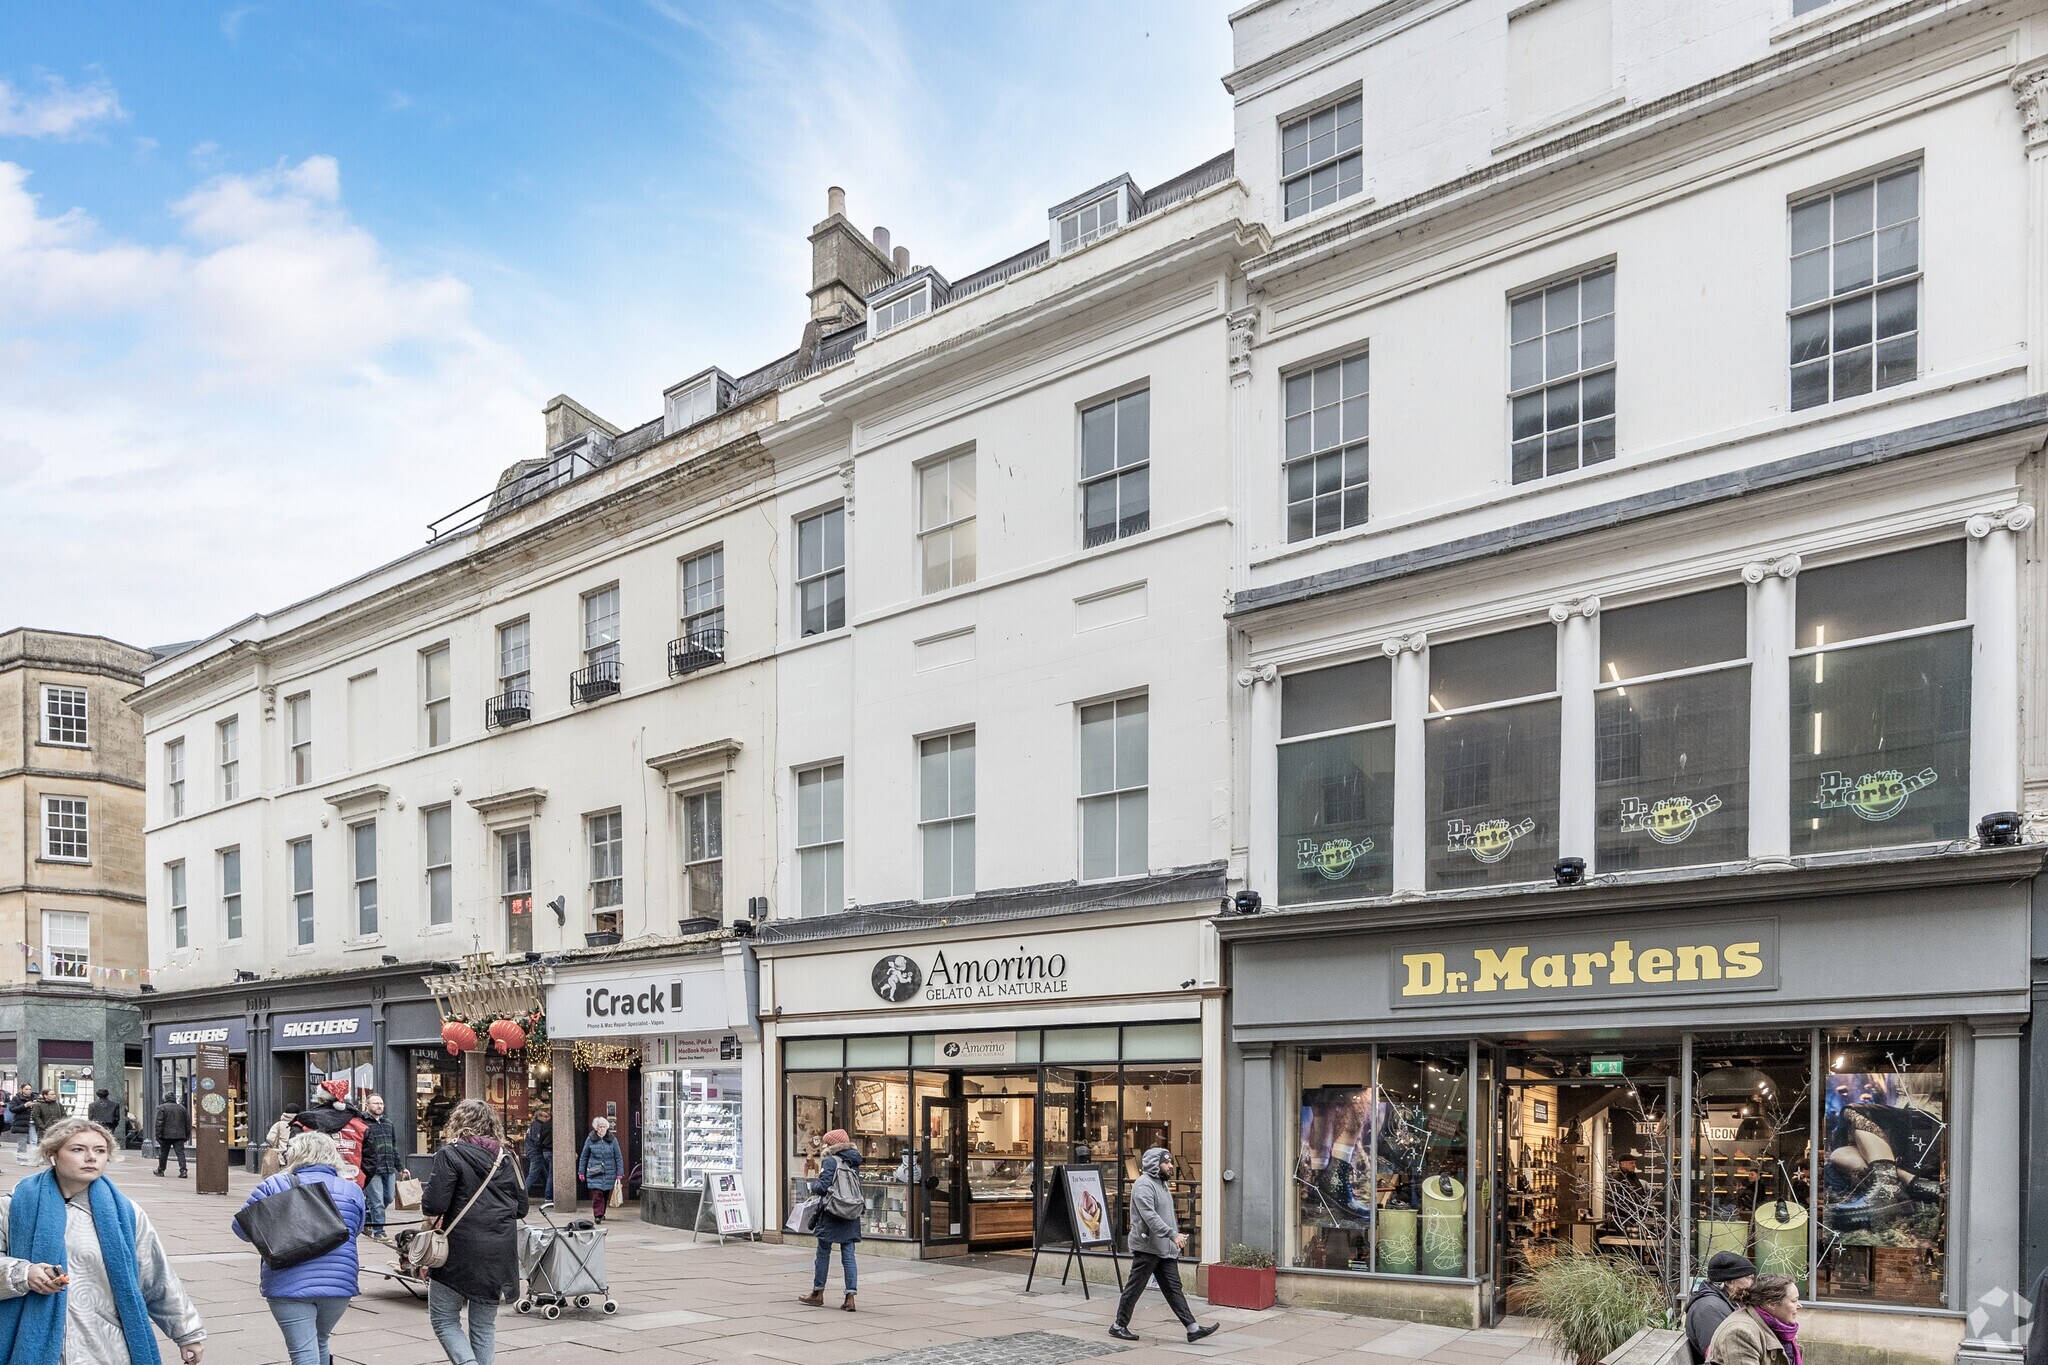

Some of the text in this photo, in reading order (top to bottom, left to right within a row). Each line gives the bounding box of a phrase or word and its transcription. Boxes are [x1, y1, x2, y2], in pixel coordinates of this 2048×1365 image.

[1821, 767, 1938, 809] Martens
[1621, 794, 1722, 832] Martens
[1448, 817, 1535, 852] Martens
[1298, 837, 1374, 869] Martens
[462, 951, 496, 977] THE
[925, 945, 1066, 987] Amorino
[1474, 940, 1763, 993] Martens
[586, 984, 665, 1017] iCrack
[926, 980, 1068, 1001] GELATO AL NATURALE
[168, 1027, 229, 1045] SKECHERS
[282, 1018, 360, 1037] SKECHERS
[961, 1041, 1005, 1053] Amorino
[510, 1089, 522, 1097] OFF
[1639, 1123, 1658, 1133] THE
